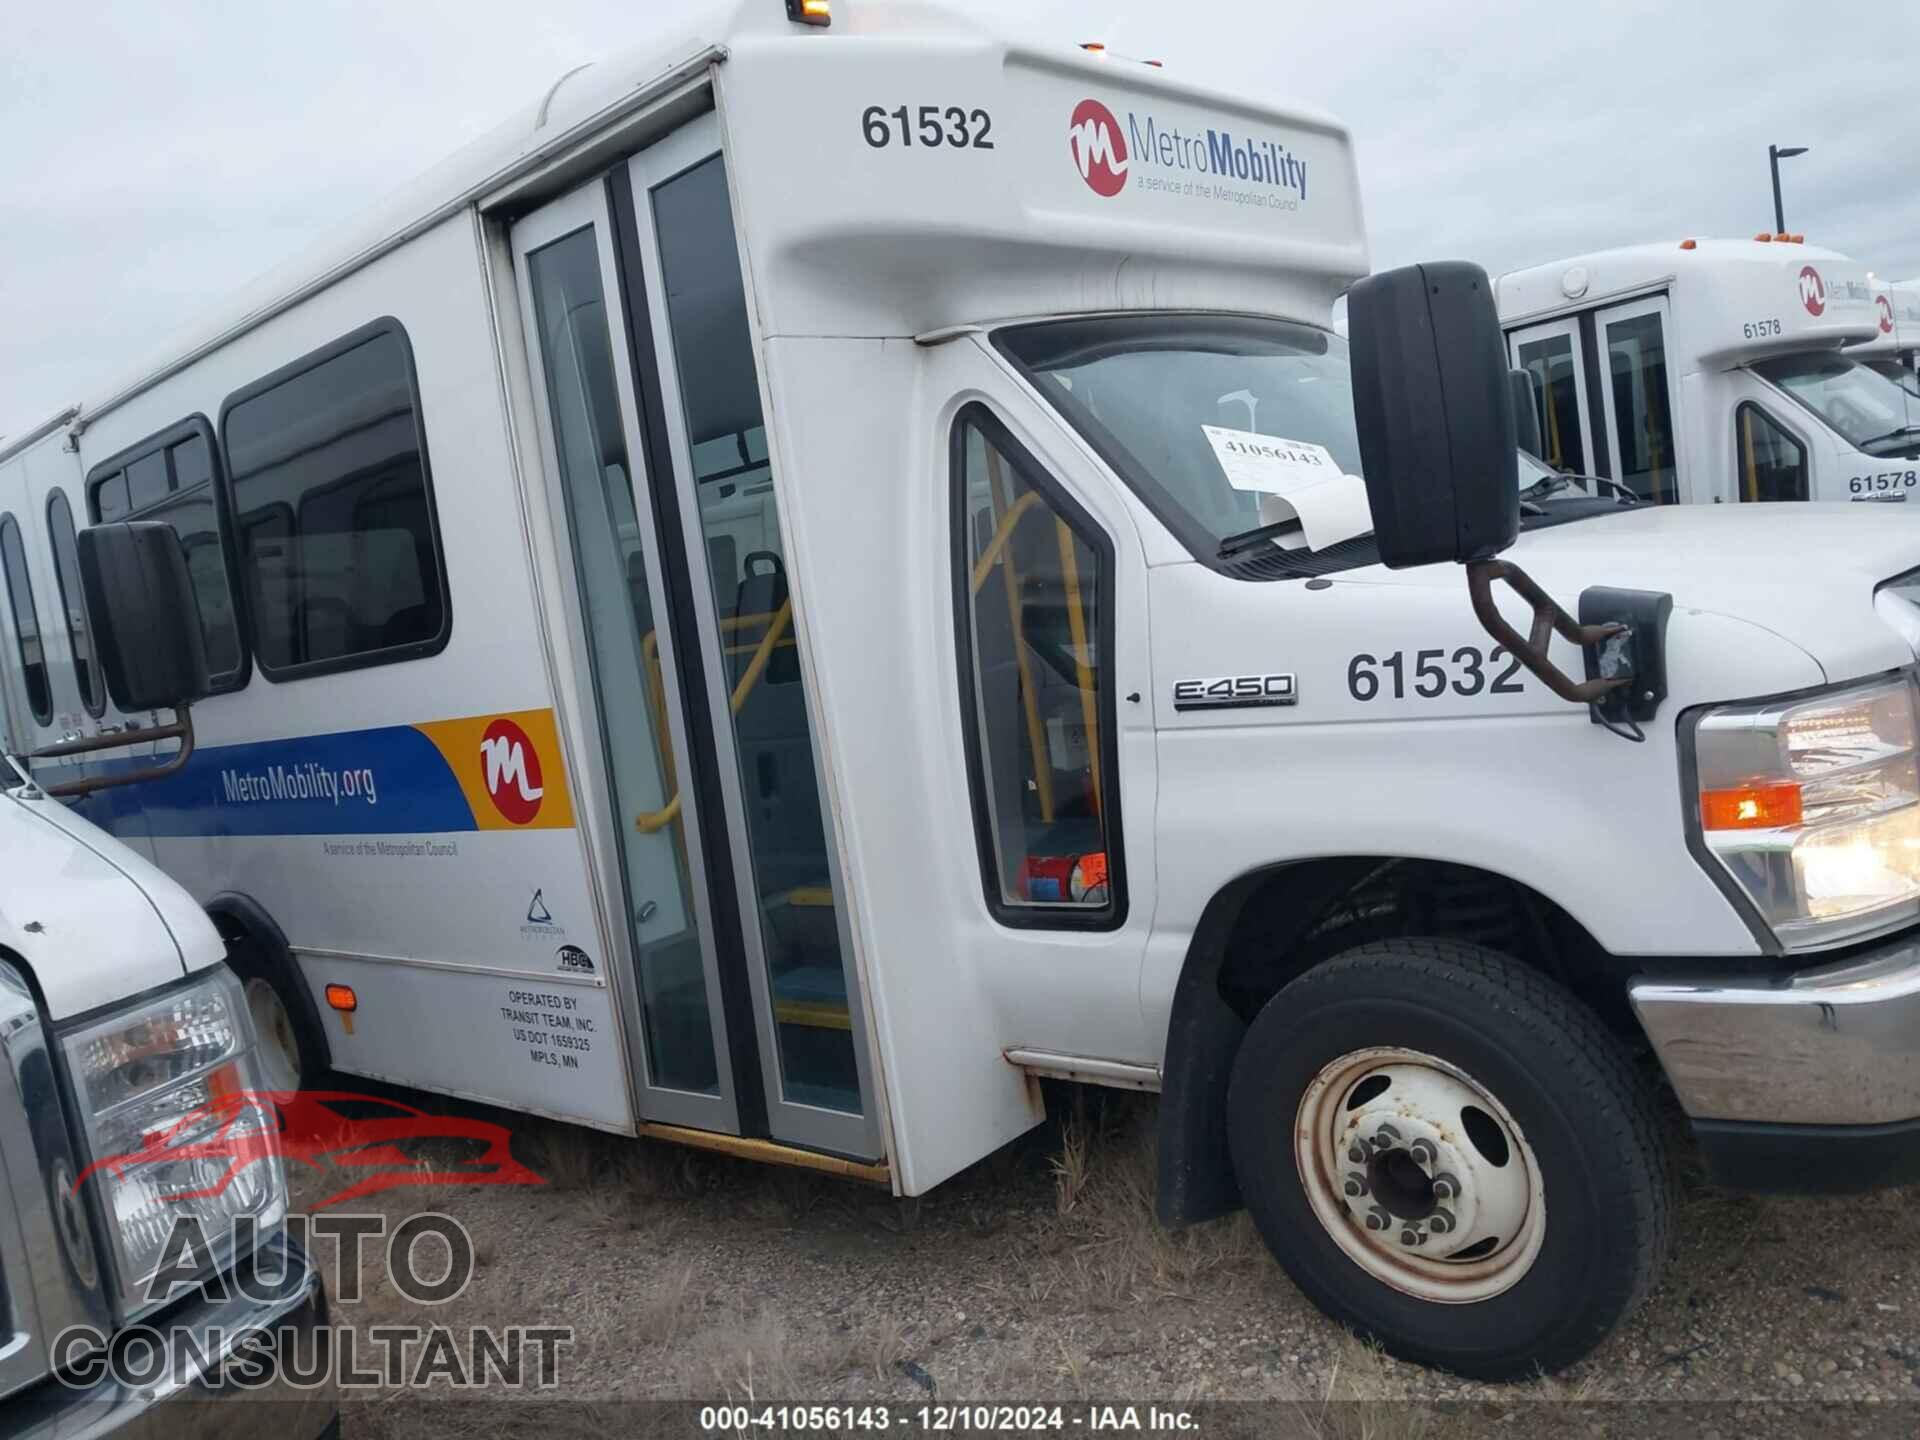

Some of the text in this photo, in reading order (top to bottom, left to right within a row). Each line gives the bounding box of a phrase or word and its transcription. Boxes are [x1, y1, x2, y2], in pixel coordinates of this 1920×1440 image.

[862, 105, 994, 149] 61532
[1128, 113, 1306, 200] MetroMobility
[1146, 177, 1182, 193] service
[1184, 182, 1193, 196] of
[1196, 182, 1211, 197] the
[1213, 185, 1267, 207] Metropolitan
[1268, 194, 1298, 211] Council
[1743, 318, 1781, 339] 61578
[1225, 441, 1322, 466] 41056143
[1849, 470, 1917, 493] 61578
[1347, 645, 1525, 702] 61532
[1175, 675, 1292, 700] E-450
[222, 762, 377, 806] MetroMobility.org
[508, 990, 577, 1010] OPERATED BY
[500, 1007, 598, 1032] TRANSIT TEAM, INC.
[513, 1028, 590, 1051] US DOT 1659325
[530, 1049, 579, 1069] MPLS, MN
